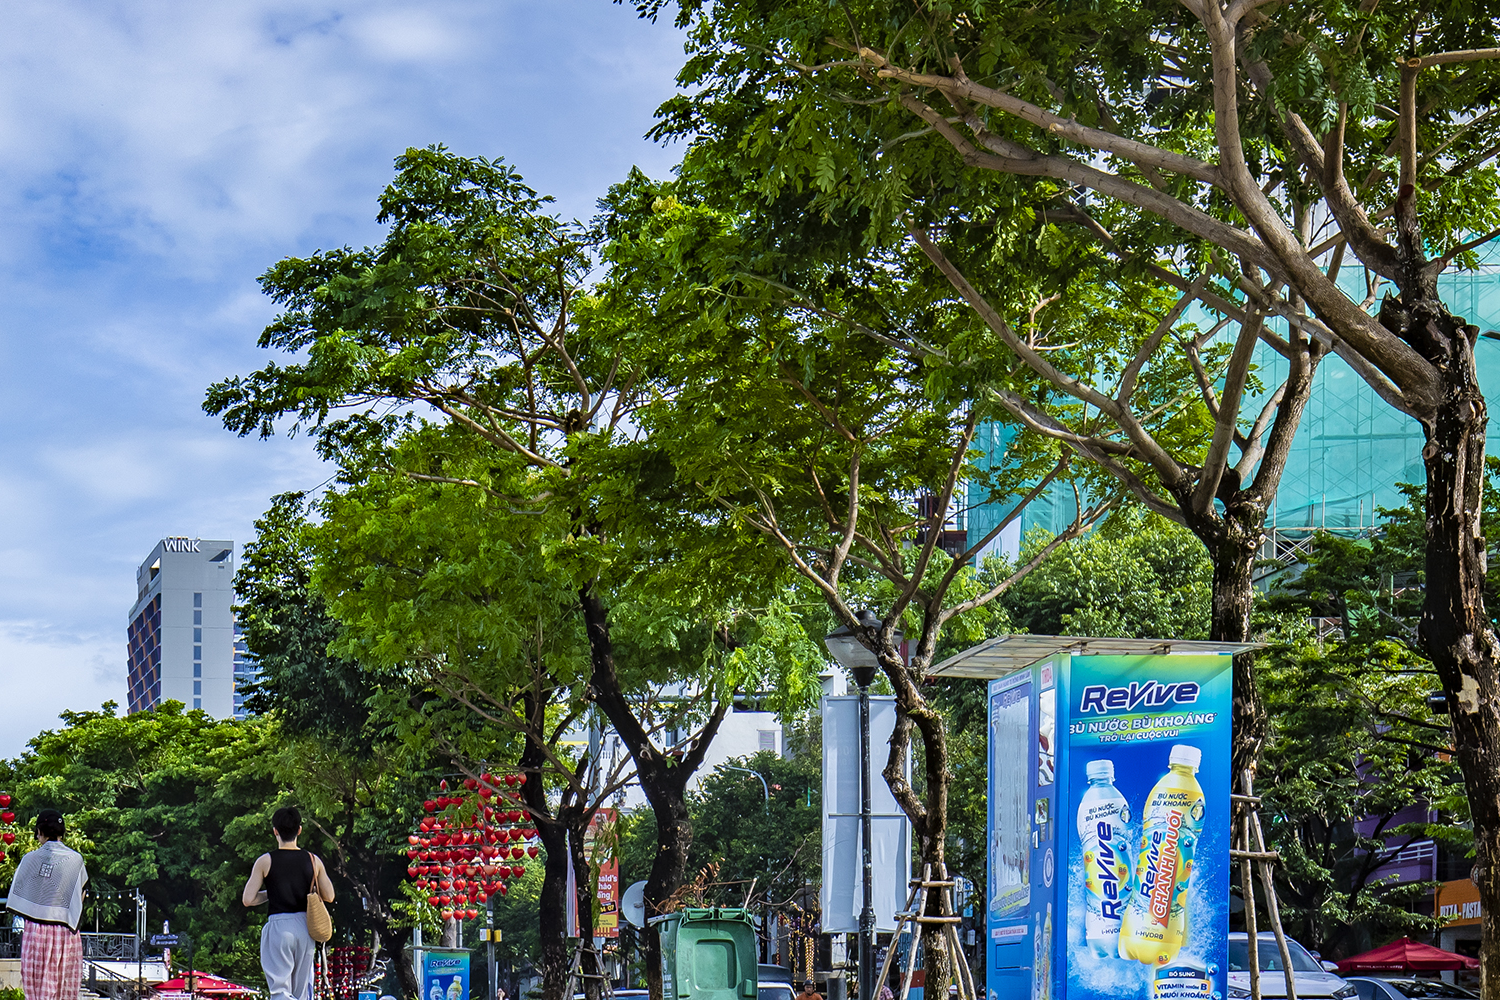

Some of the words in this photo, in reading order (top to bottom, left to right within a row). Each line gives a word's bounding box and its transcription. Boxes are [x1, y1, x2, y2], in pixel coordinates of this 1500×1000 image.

[163, 540, 201, 553] WINK
[1080, 679, 1201, 714] ReVive
[1088, 718, 1129, 733] NƯỚC
[1132, 715, 1153, 730] BÙ
[1163, 729, 1180, 738] VUI
[1163, 809, 1183, 857] MUỐI
[1096, 821, 1122, 921] ReVive
[1140, 830, 1163, 899] ReVive
[1152, 855, 1176, 919] CHANH
[1462, 901, 1482, 919] PASTA
[430, 958, 462, 968] ReVive
[1180, 991, 1211, 1000] KHOÁNG
[1200, 983, 1208, 991] B
